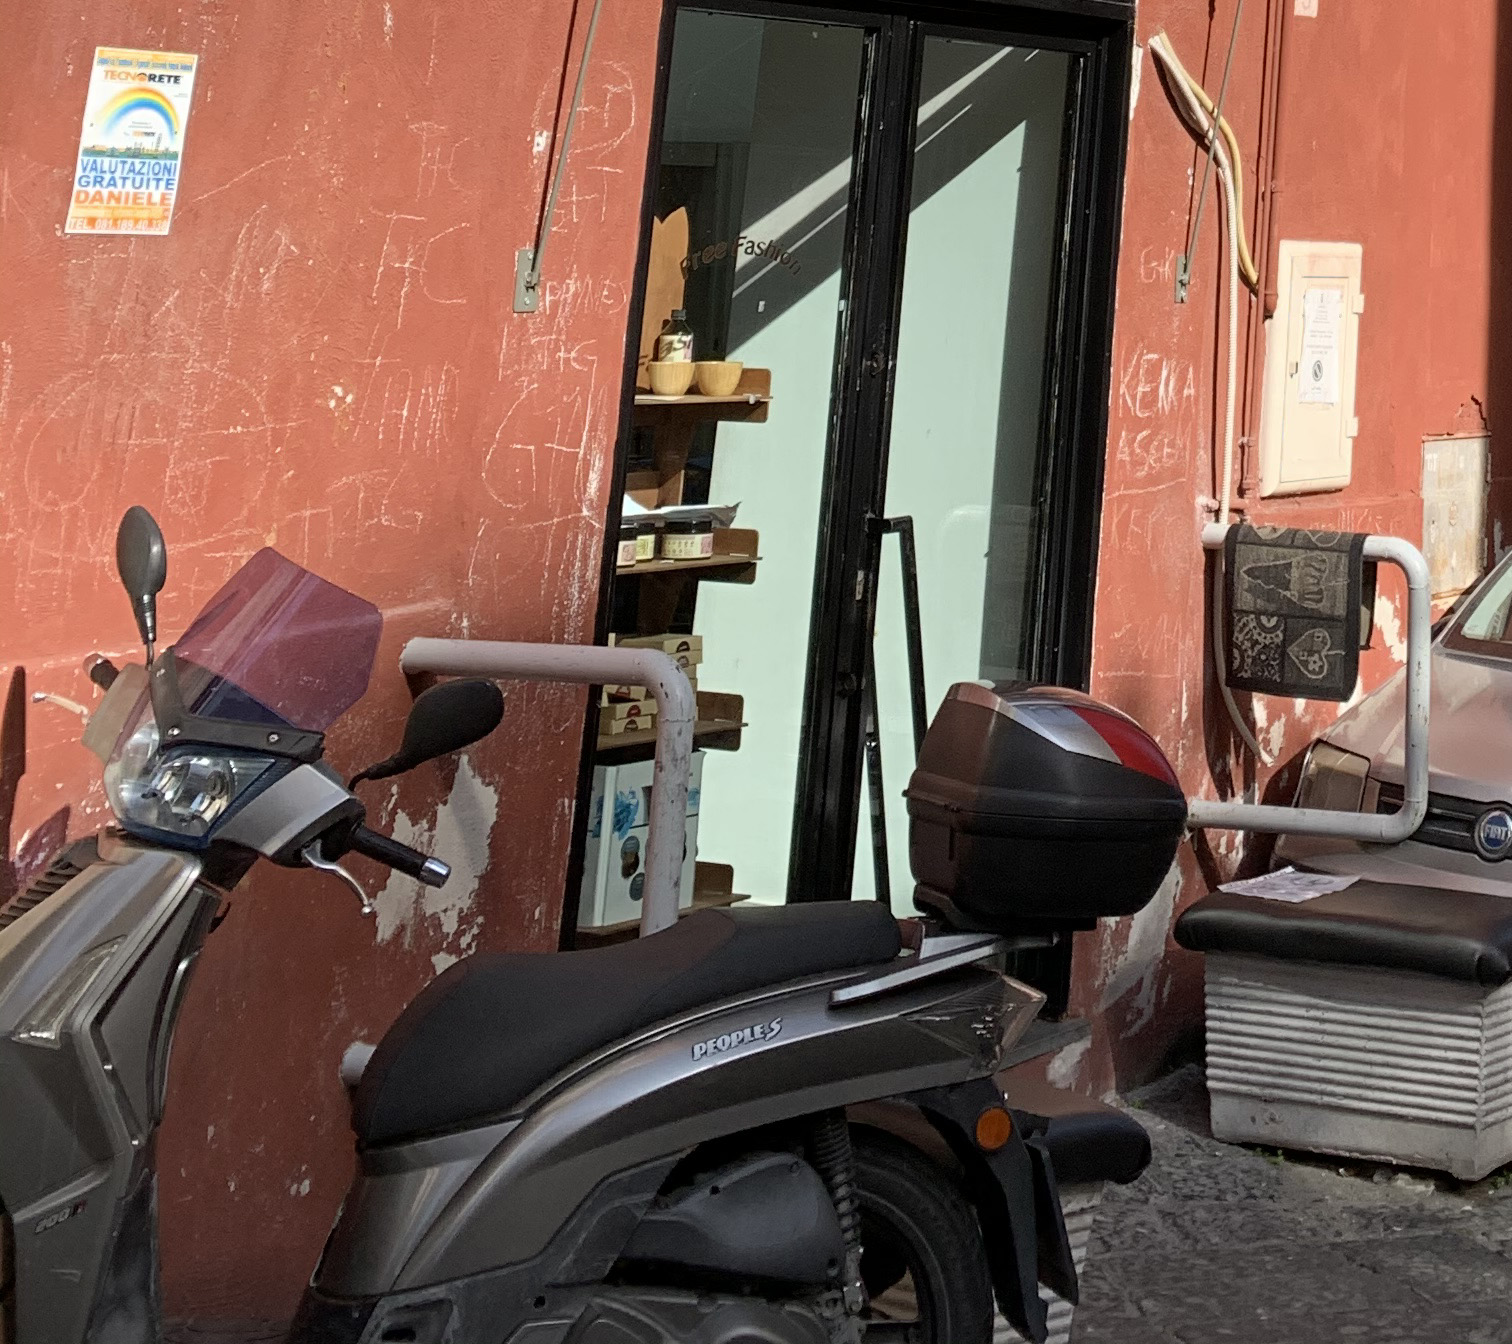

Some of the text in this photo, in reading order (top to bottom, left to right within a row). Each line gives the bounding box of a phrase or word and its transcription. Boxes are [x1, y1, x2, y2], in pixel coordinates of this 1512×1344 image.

[81, 158, 177, 177] VALUTAZIONI
[77, 174, 177, 191] GRATUITE
[75, 190, 172, 206] DANIELE
[731, 235, 802, 276] Fashion
[1484, 823, 1508, 841] FIAT
